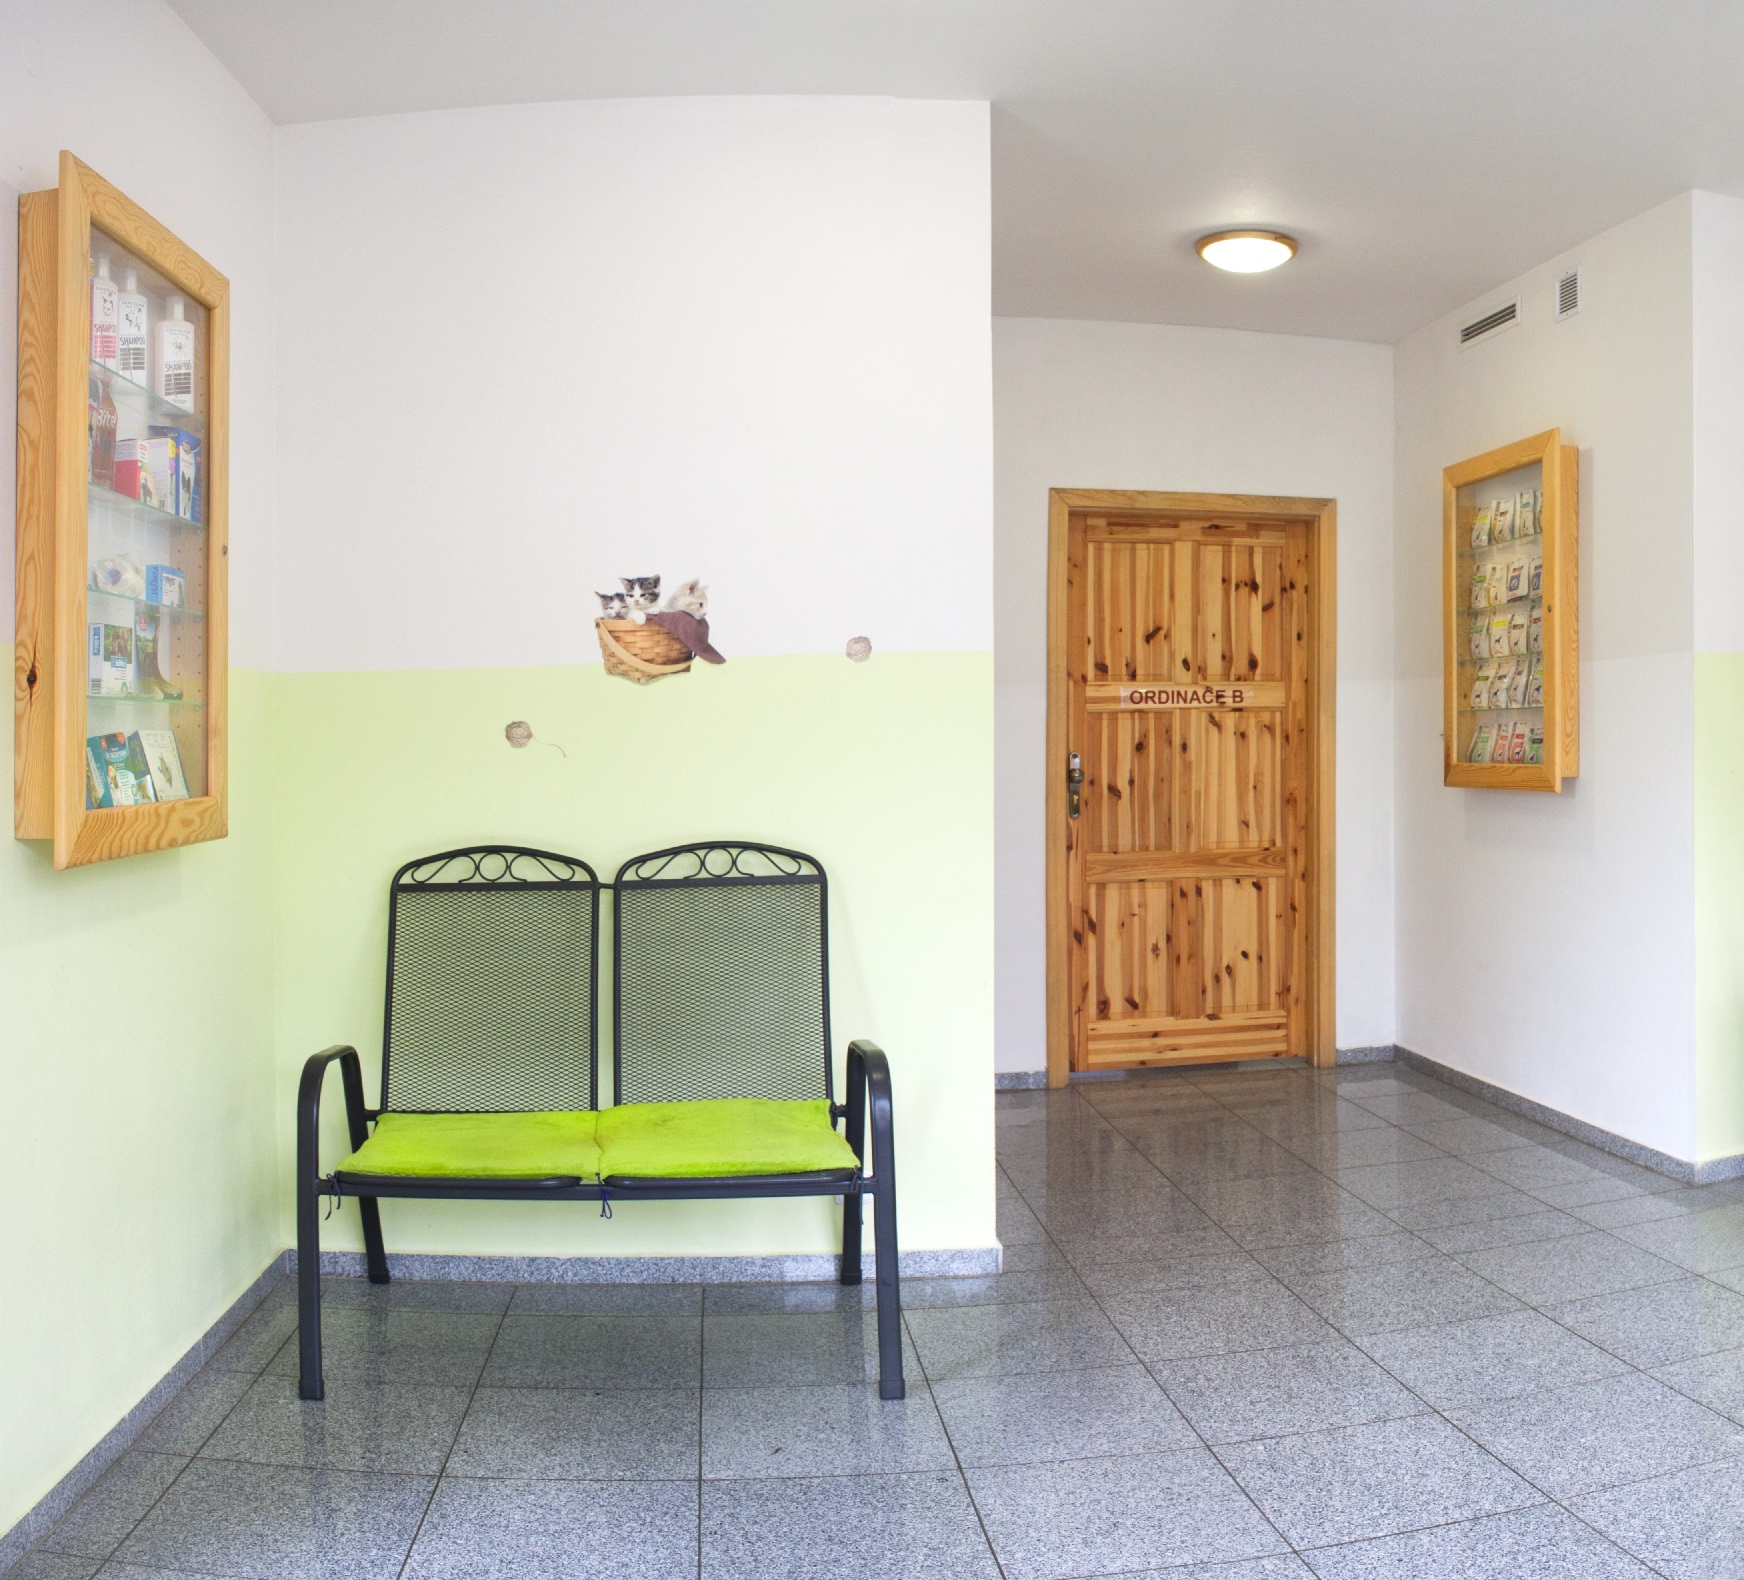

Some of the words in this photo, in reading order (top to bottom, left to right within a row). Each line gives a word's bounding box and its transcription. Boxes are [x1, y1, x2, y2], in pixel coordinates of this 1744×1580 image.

[119, 336, 146, 346] SHAMPOO
[1129, 689, 1226, 705] ORDINACE
[1232, 689, 1244, 704] B
